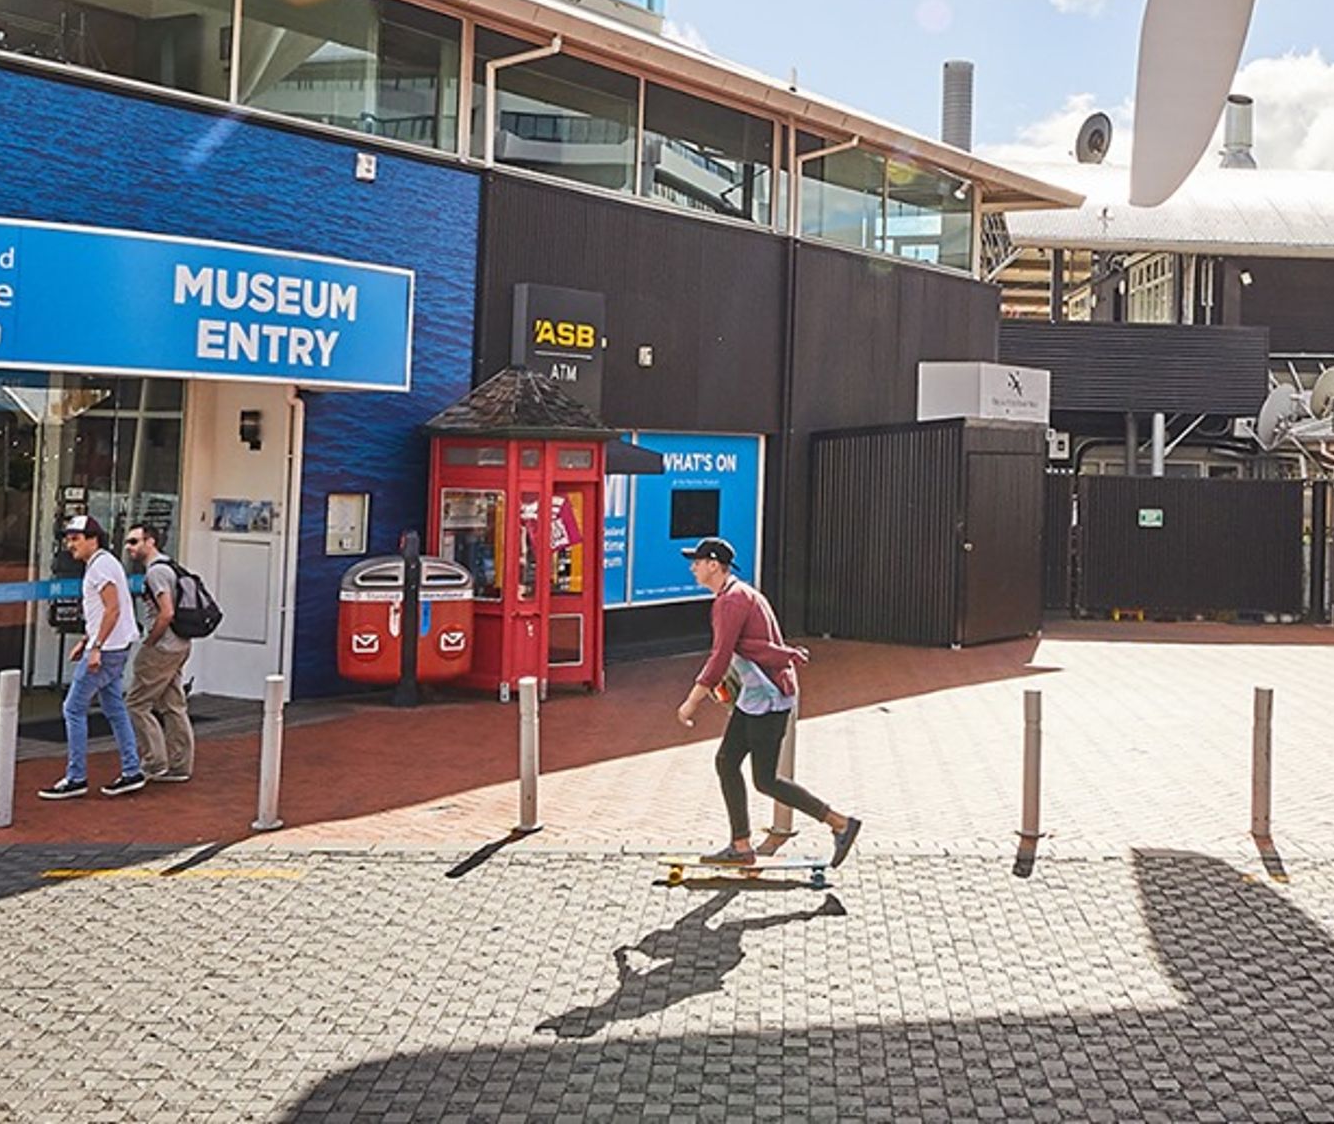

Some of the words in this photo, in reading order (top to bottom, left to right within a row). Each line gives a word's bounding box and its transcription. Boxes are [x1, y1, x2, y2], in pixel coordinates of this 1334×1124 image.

[173, 264, 358, 322] MUSEUM
[196, 319, 339, 367] ENTRY
[549, 363, 577, 382] ATM
[717, 454, 738, 473] ON
